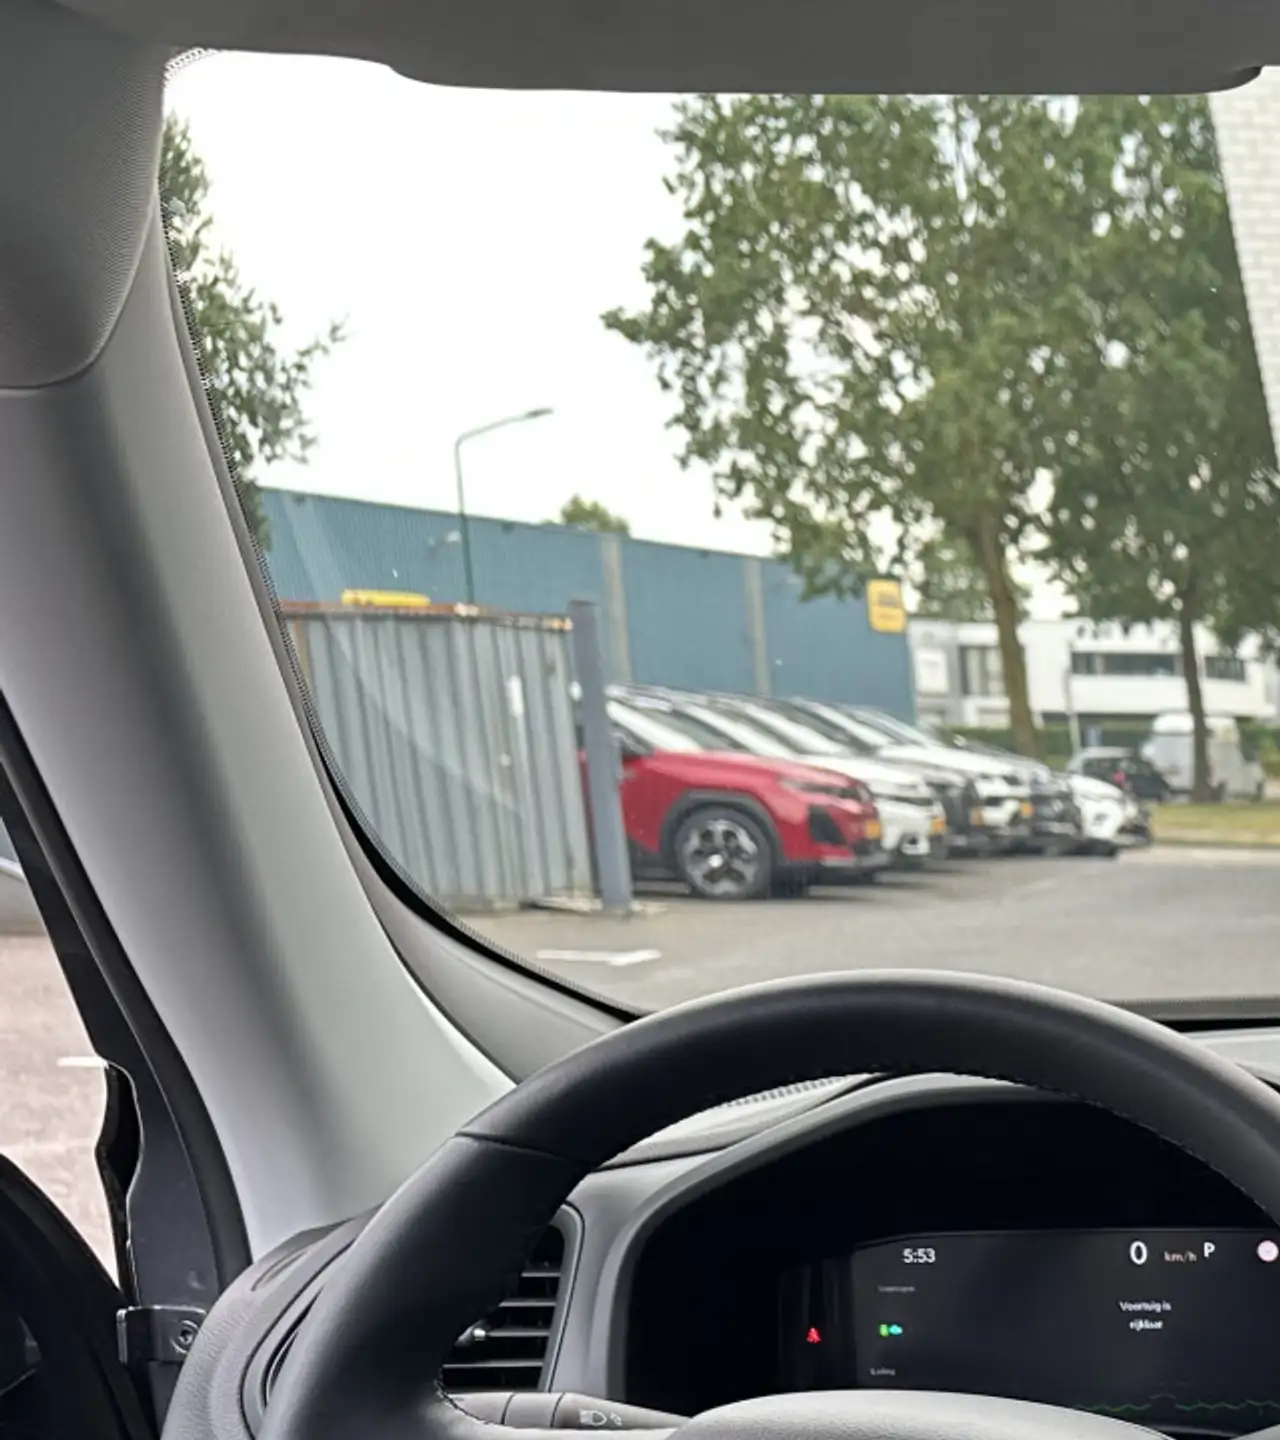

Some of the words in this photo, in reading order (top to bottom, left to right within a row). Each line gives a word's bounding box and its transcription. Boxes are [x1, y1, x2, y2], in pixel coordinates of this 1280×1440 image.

[902, 1247, 936, 1264] 5:53
[1129, 1240, 1148, 1265] 0
[1163, 1249, 1198, 1263] km/h
[1203, 1241, 1216, 1258] P
